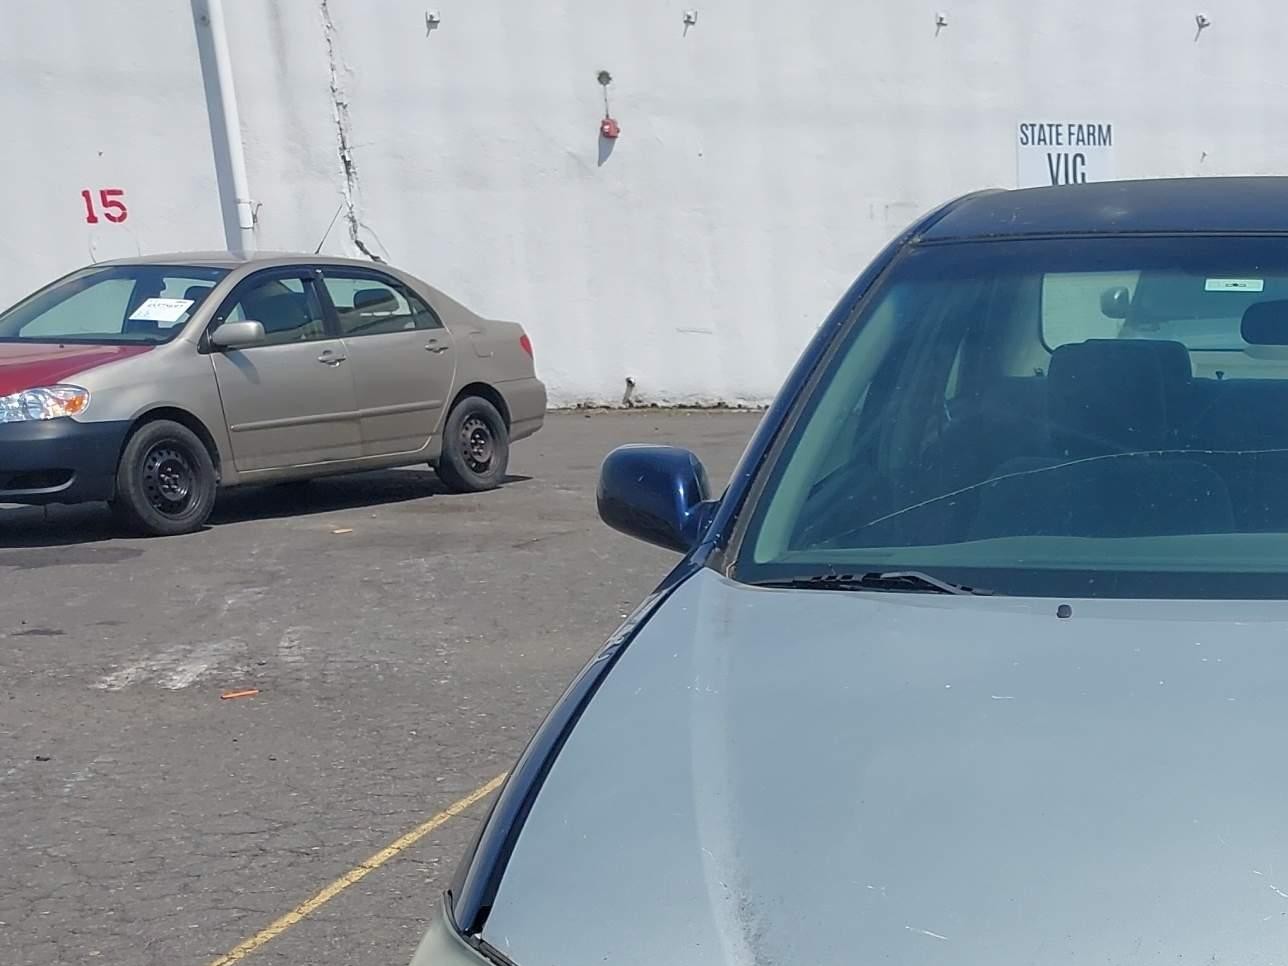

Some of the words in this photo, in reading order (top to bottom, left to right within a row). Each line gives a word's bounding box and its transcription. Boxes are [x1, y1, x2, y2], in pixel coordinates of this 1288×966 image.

[1019, 122, 1064, 146] STATE
[1067, 123, 1113, 147] FARM
[1047, 152, 1087, 186] VIC
[81, 189, 128, 224] 15
